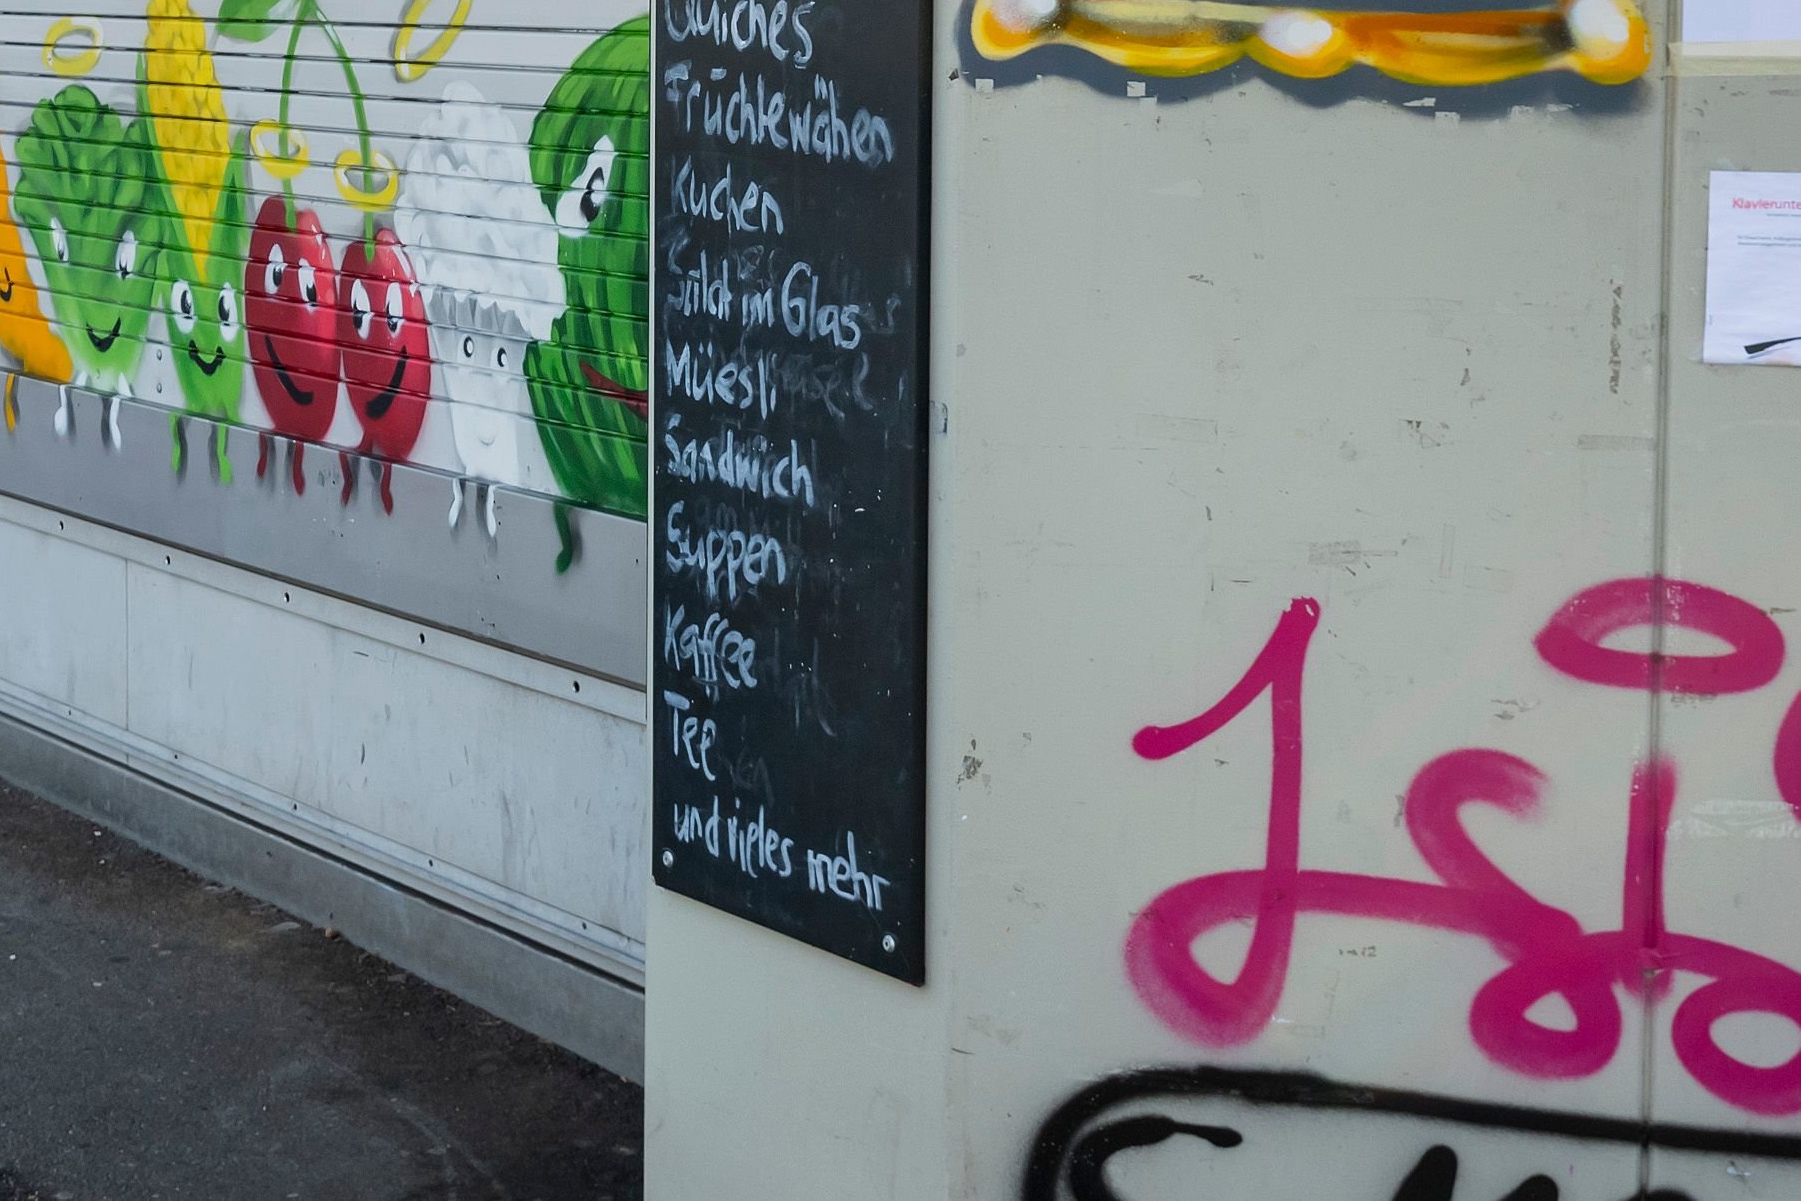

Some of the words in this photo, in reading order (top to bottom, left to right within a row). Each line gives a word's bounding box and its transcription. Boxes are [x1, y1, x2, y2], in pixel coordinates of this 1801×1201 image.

[671, 155, 784, 235] Kuchen
[781, 261, 861, 349] Glas
[665, 413, 815, 507] Sandwich
[665, 500, 787, 599] Suppen
[665, 604, 757, 697] Kaffee
[664, 690, 716, 781] Tee
[674, 795, 719, 859] und
[808, 830, 891, 911] mehr
